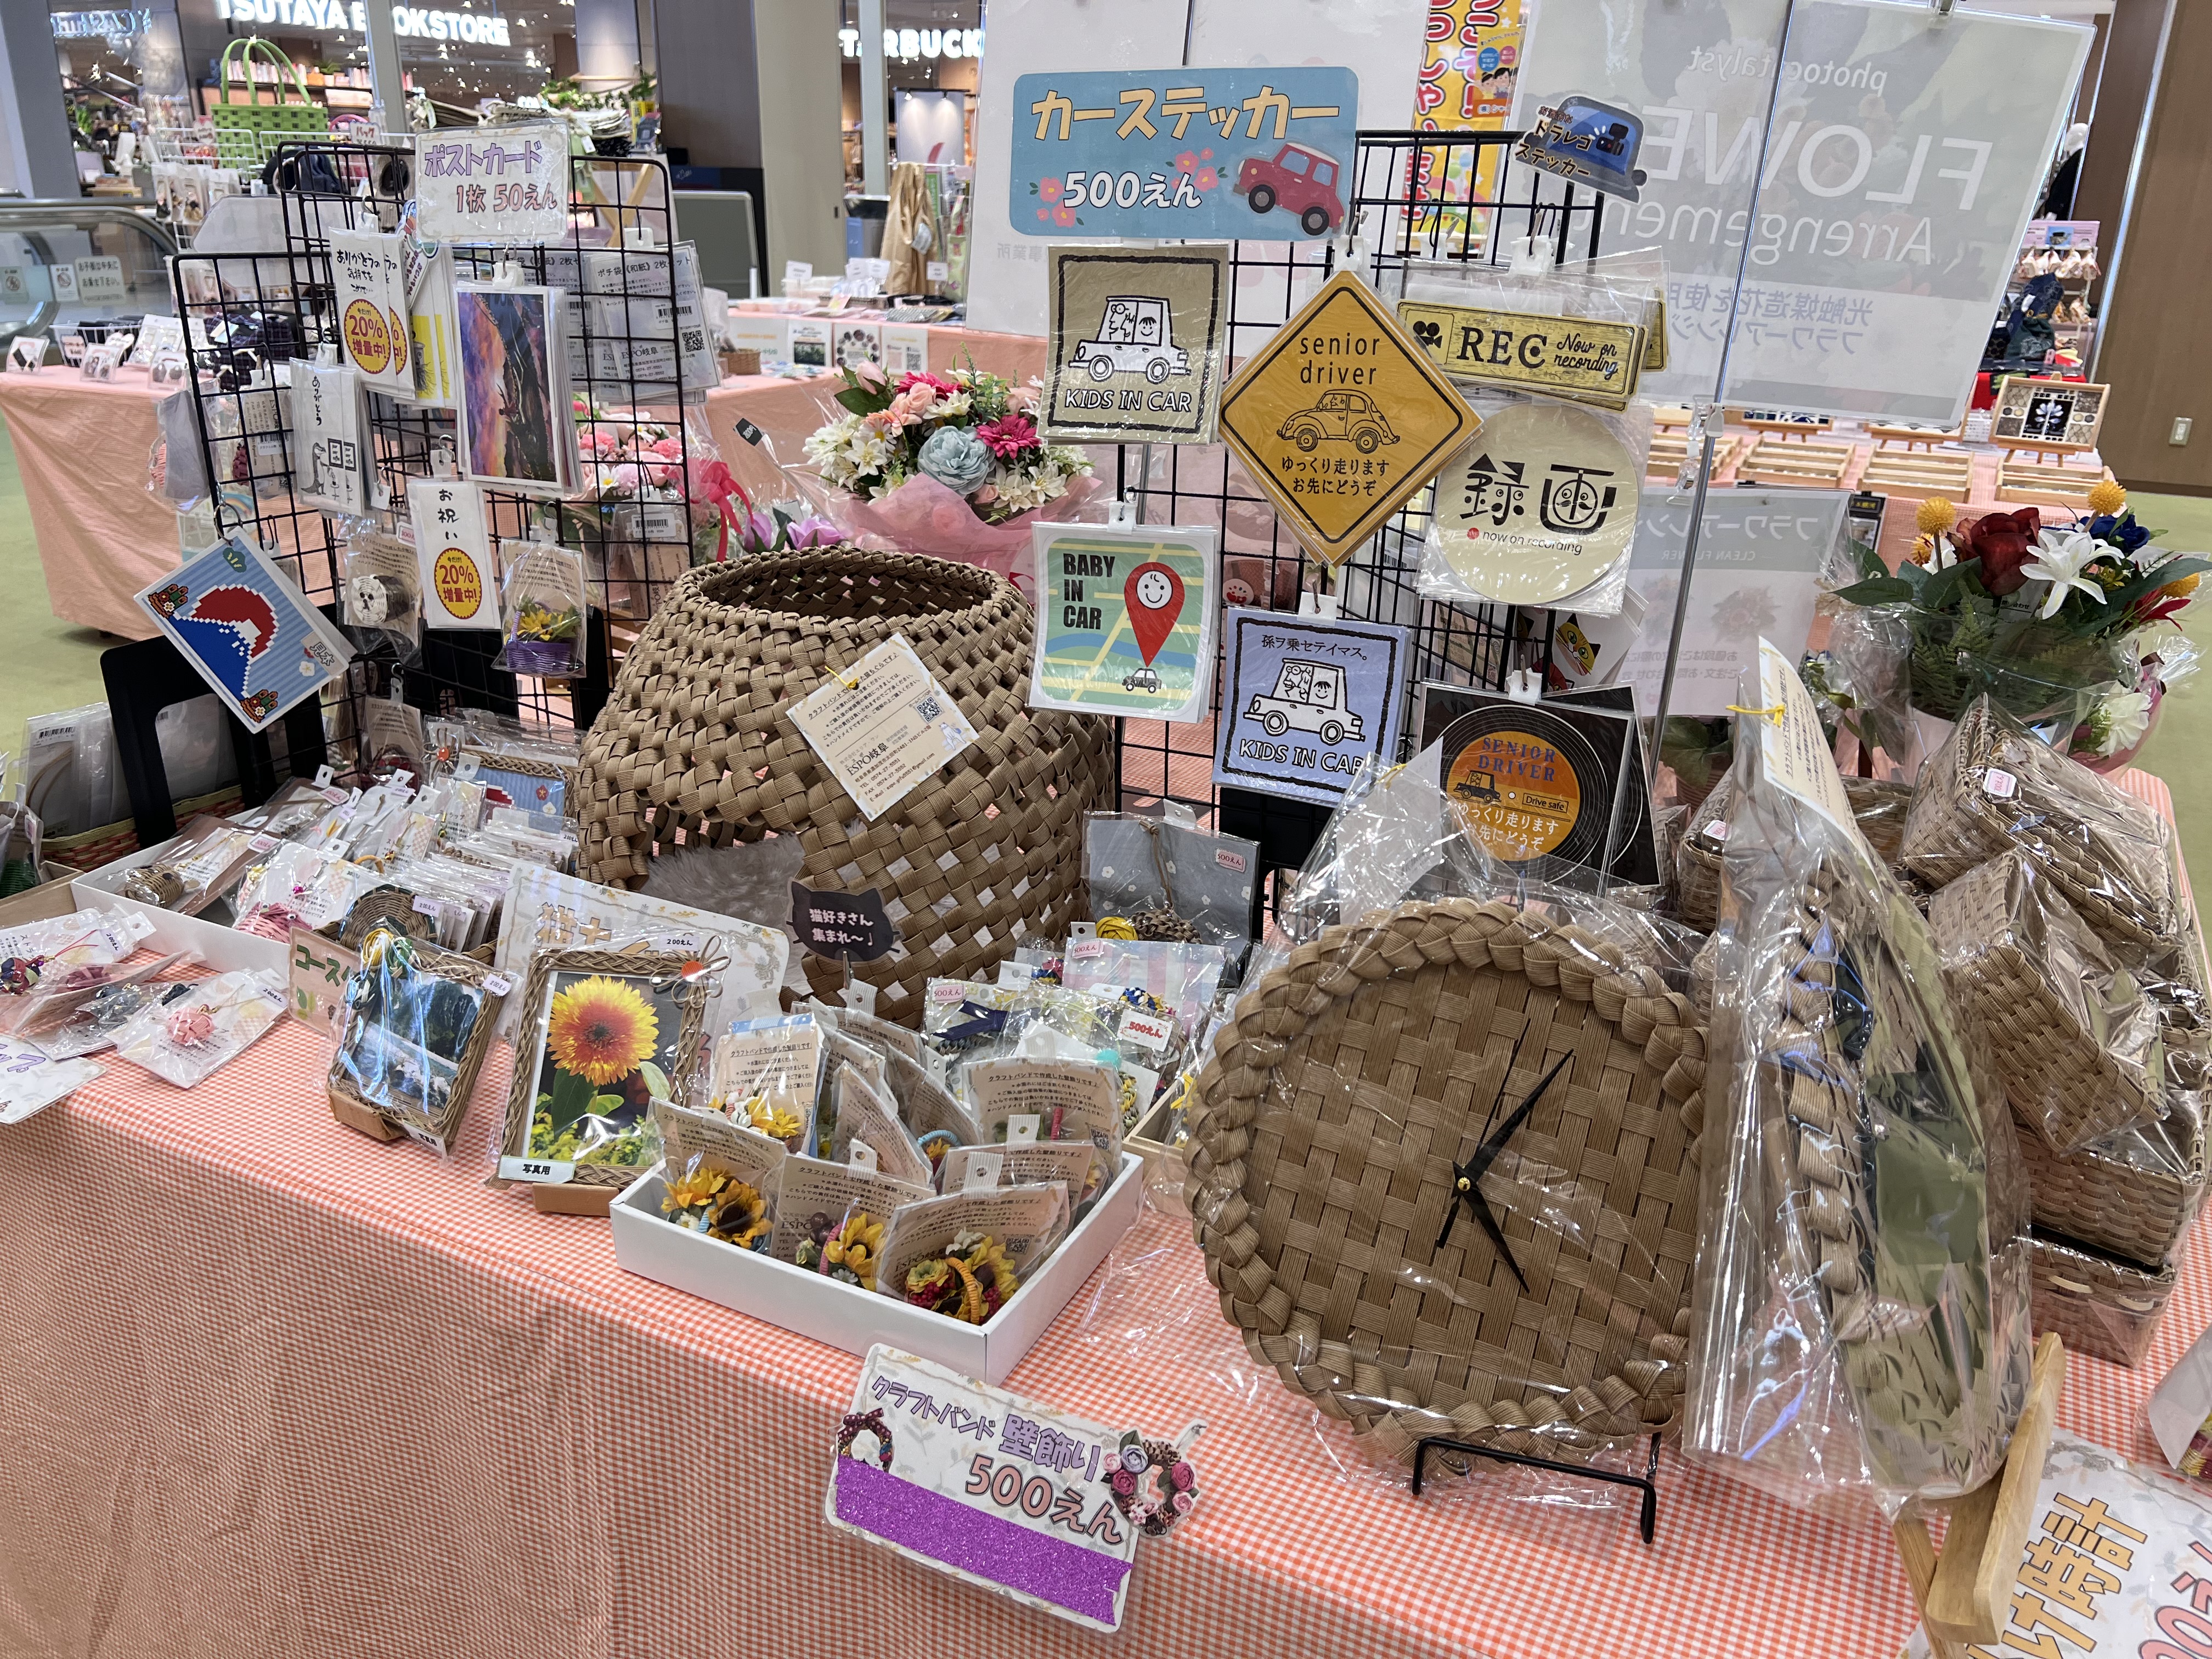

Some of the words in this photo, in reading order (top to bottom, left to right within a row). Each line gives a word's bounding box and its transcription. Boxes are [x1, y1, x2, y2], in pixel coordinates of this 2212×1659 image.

[352, 2, 511, 46] BOKSTORE
[1032, 86, 1340, 140] カーステッカー
[1533, 119, 1593, 151] ドラレコ
[425, 140, 543, 177] ポストカード
[1515, 142, 1591, 177] ステッカー
[456, 183, 486, 212] 1枚
[493, 183, 558, 212] 50えん
[1063, 171, 1203, 209] 500えん
[336, 249, 381, 268] ありがとうの
[348, 314, 383, 339] 20%
[352, 338, 387, 359] 増量中!
[1300, 332, 1380, 356] senior
[1456, 326, 1547, 369] REC
[1556, 332, 1595, 354] Now
[1600, 342, 1618, 357] on
[1300, 360, 1378, 385] driver
[1554, 353, 1619, 381] recording
[312, 375, 322, 426] ありがとう
[1065, 389, 1115, 409] KIDS
[1119, 390, 1143, 411] IN
[1147, 392, 1192, 413] CAR
[1282, 456, 1390, 477] ゆっくり走ります
[1293, 477, 1377, 496] お先にどうぞ
[1459, 453, 1617, 536] 録画
[438, 489, 459, 539] お祝い
[1482, 531, 1509, 544] now
[1510, 535, 1525, 546] on
[439, 564, 473, 585] 20%
[1063, 552, 1116, 578] BABY
[443, 587, 477, 603] 増量中!
[1063, 578, 1084, 602] IN
[1063, 605, 1102, 630] CAR
[309, 641, 335, 667] 見本
[1261, 634, 1367, 661] 孫ヲ乗セテイマス。
[1239, 738, 1289, 764] KIDS
[1292, 747, 1317, 769] IN
[1321, 752, 1366, 776] CAR
[1482, 737, 1556, 764] SENIOR
[1478, 754, 1555, 782] DRIVER
[1526, 795, 1547, 808] Drive
[1548, 798, 1565, 811] safe
[1458, 802, 1559, 836] ゆっくり走ります
[1217, 854, 1242, 866] 500えん
[419, 902, 437, 911] 200えん
[809, 908, 874, 927] 猫好きさん
[1074, 944, 1097, 953] 500えん
[263, 988, 283, 1003] 200えん
[489, 980, 507, 992] 200えん
[934, 988, 961, 997] 500えん
[1128, 1021, 1164, 1039] 500えん
[522, 1164, 551, 1176] 写真用
[873, 1376, 996, 1441] クラフトバンド
[998, 1414, 1102, 1482] 壁飾り
[965, 1452, 1125, 1546] 500えん
